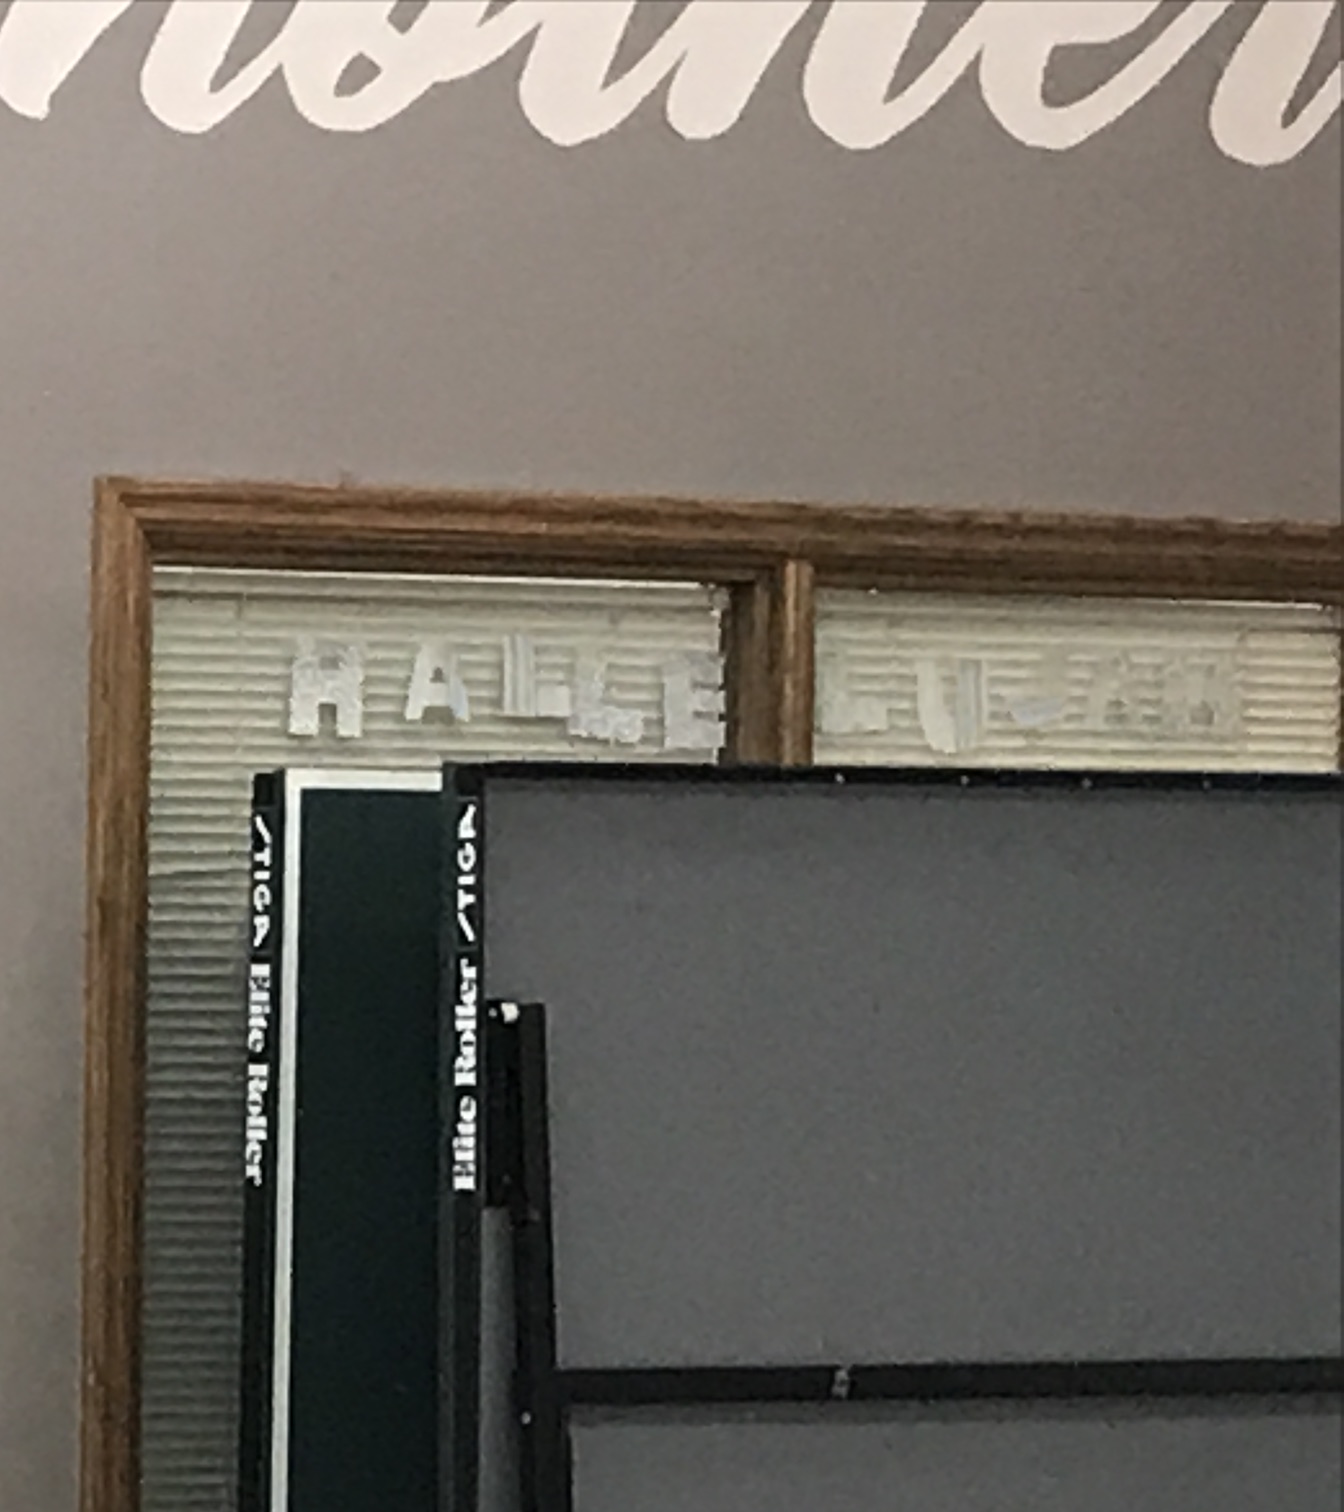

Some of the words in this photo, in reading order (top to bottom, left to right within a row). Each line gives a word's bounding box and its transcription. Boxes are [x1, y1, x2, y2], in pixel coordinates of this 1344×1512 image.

[248, 963, 271, 1052] Elite
[454, 957, 477, 1087] Roller
[245, 1063, 269, 1186] Roller
[452, 1095, 477, 1190] Elite
